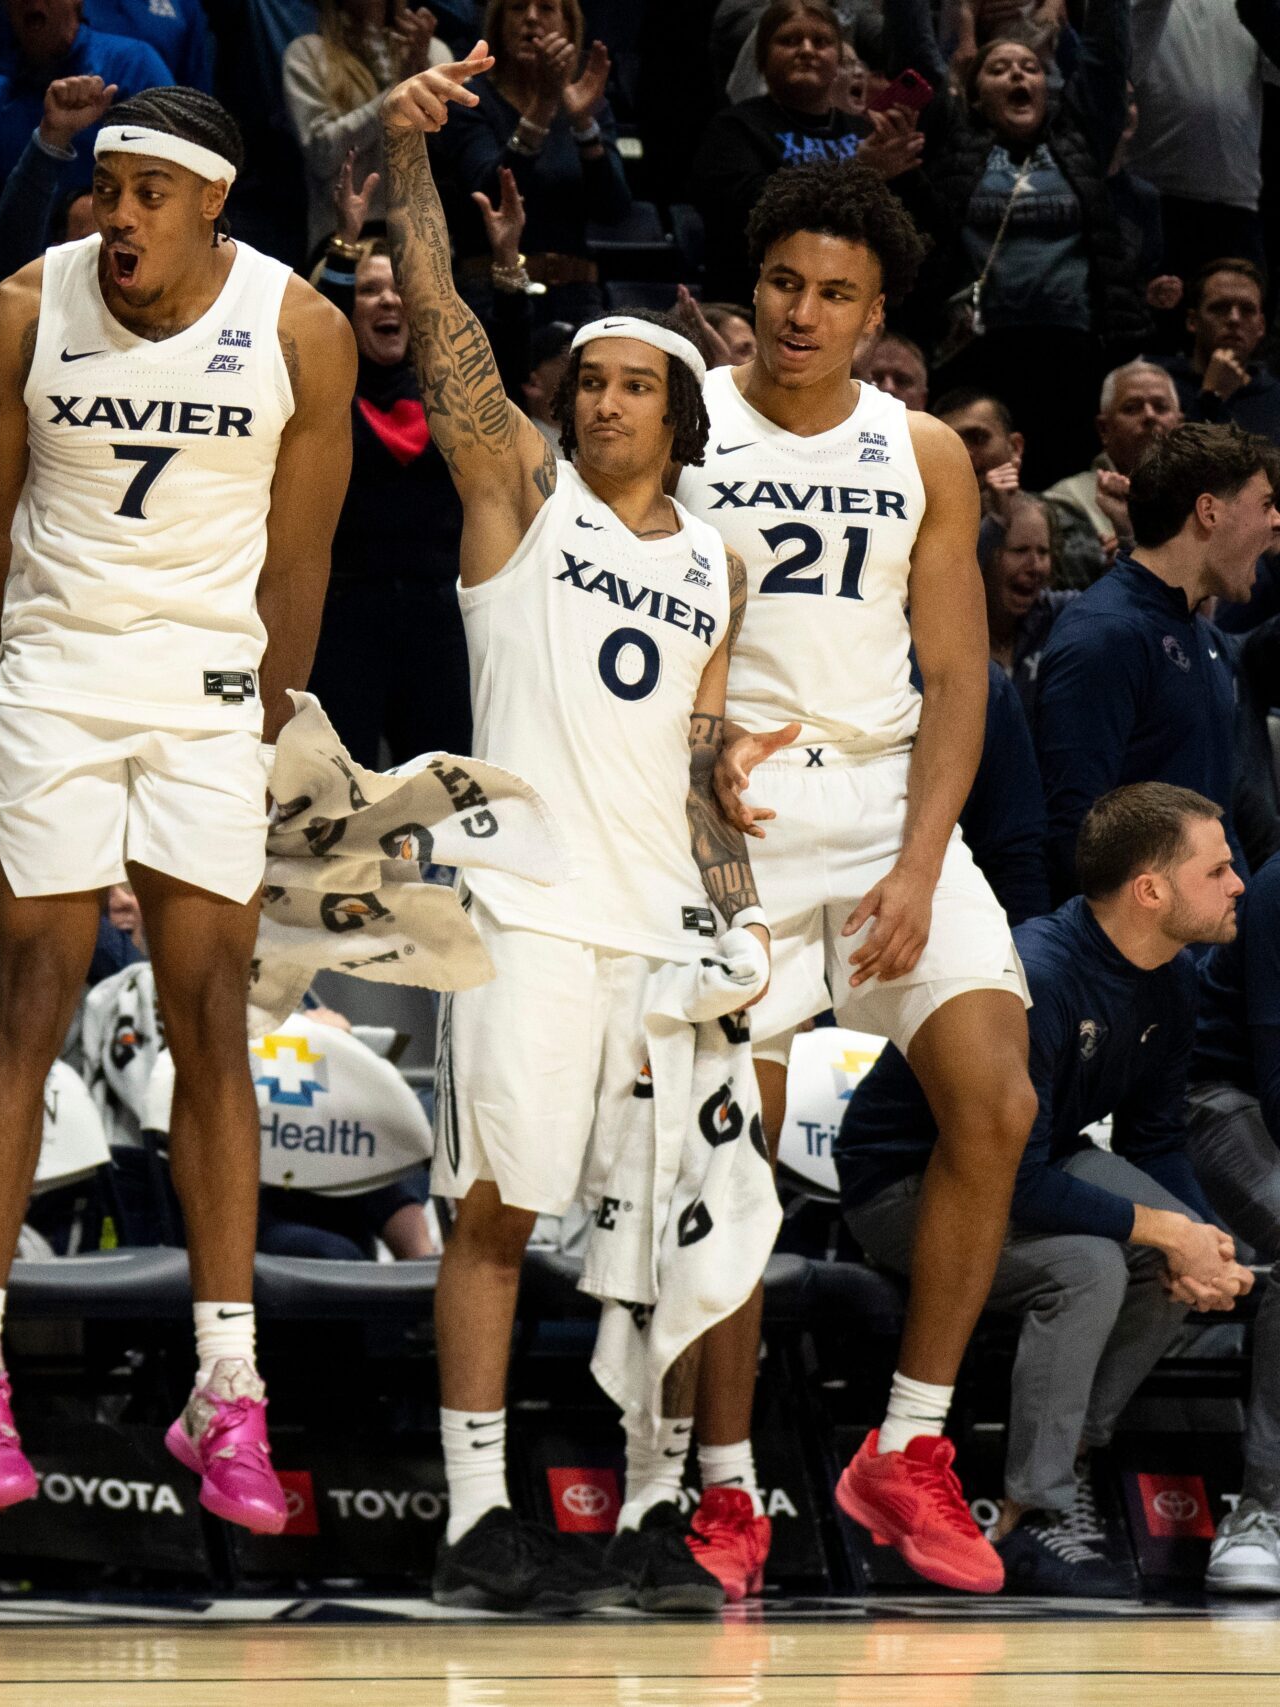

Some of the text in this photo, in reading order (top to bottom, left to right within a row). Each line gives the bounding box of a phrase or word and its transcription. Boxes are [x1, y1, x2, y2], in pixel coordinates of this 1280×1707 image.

[221, 329, 251, 340] BE THE
[217, 337, 253, 349] CHANGE
[212, 354, 239, 363] BIG
[207, 362, 245, 371] EAST
[46, 394, 255, 438] XAVIER
[858, 436, 889, 448] CHANGE
[872, 432, 886, 441] THE
[859, 453, 891, 462] EAST
[862, 447, 885, 456] BIG
[110, 443, 184, 520] 7
[707, 480, 909, 521] XAVIER
[757, 521, 872, 601] 21
[684, 573, 712, 588] EAST
[688, 567, 707, 579] BIG
[552, 549, 716, 648] XAVIER
[598, 626, 661, 702] 0
[805, 748, 825, 767] X
[797, 1121, 840, 1157] Tri
[327, 1488, 450, 1520] TOYO
